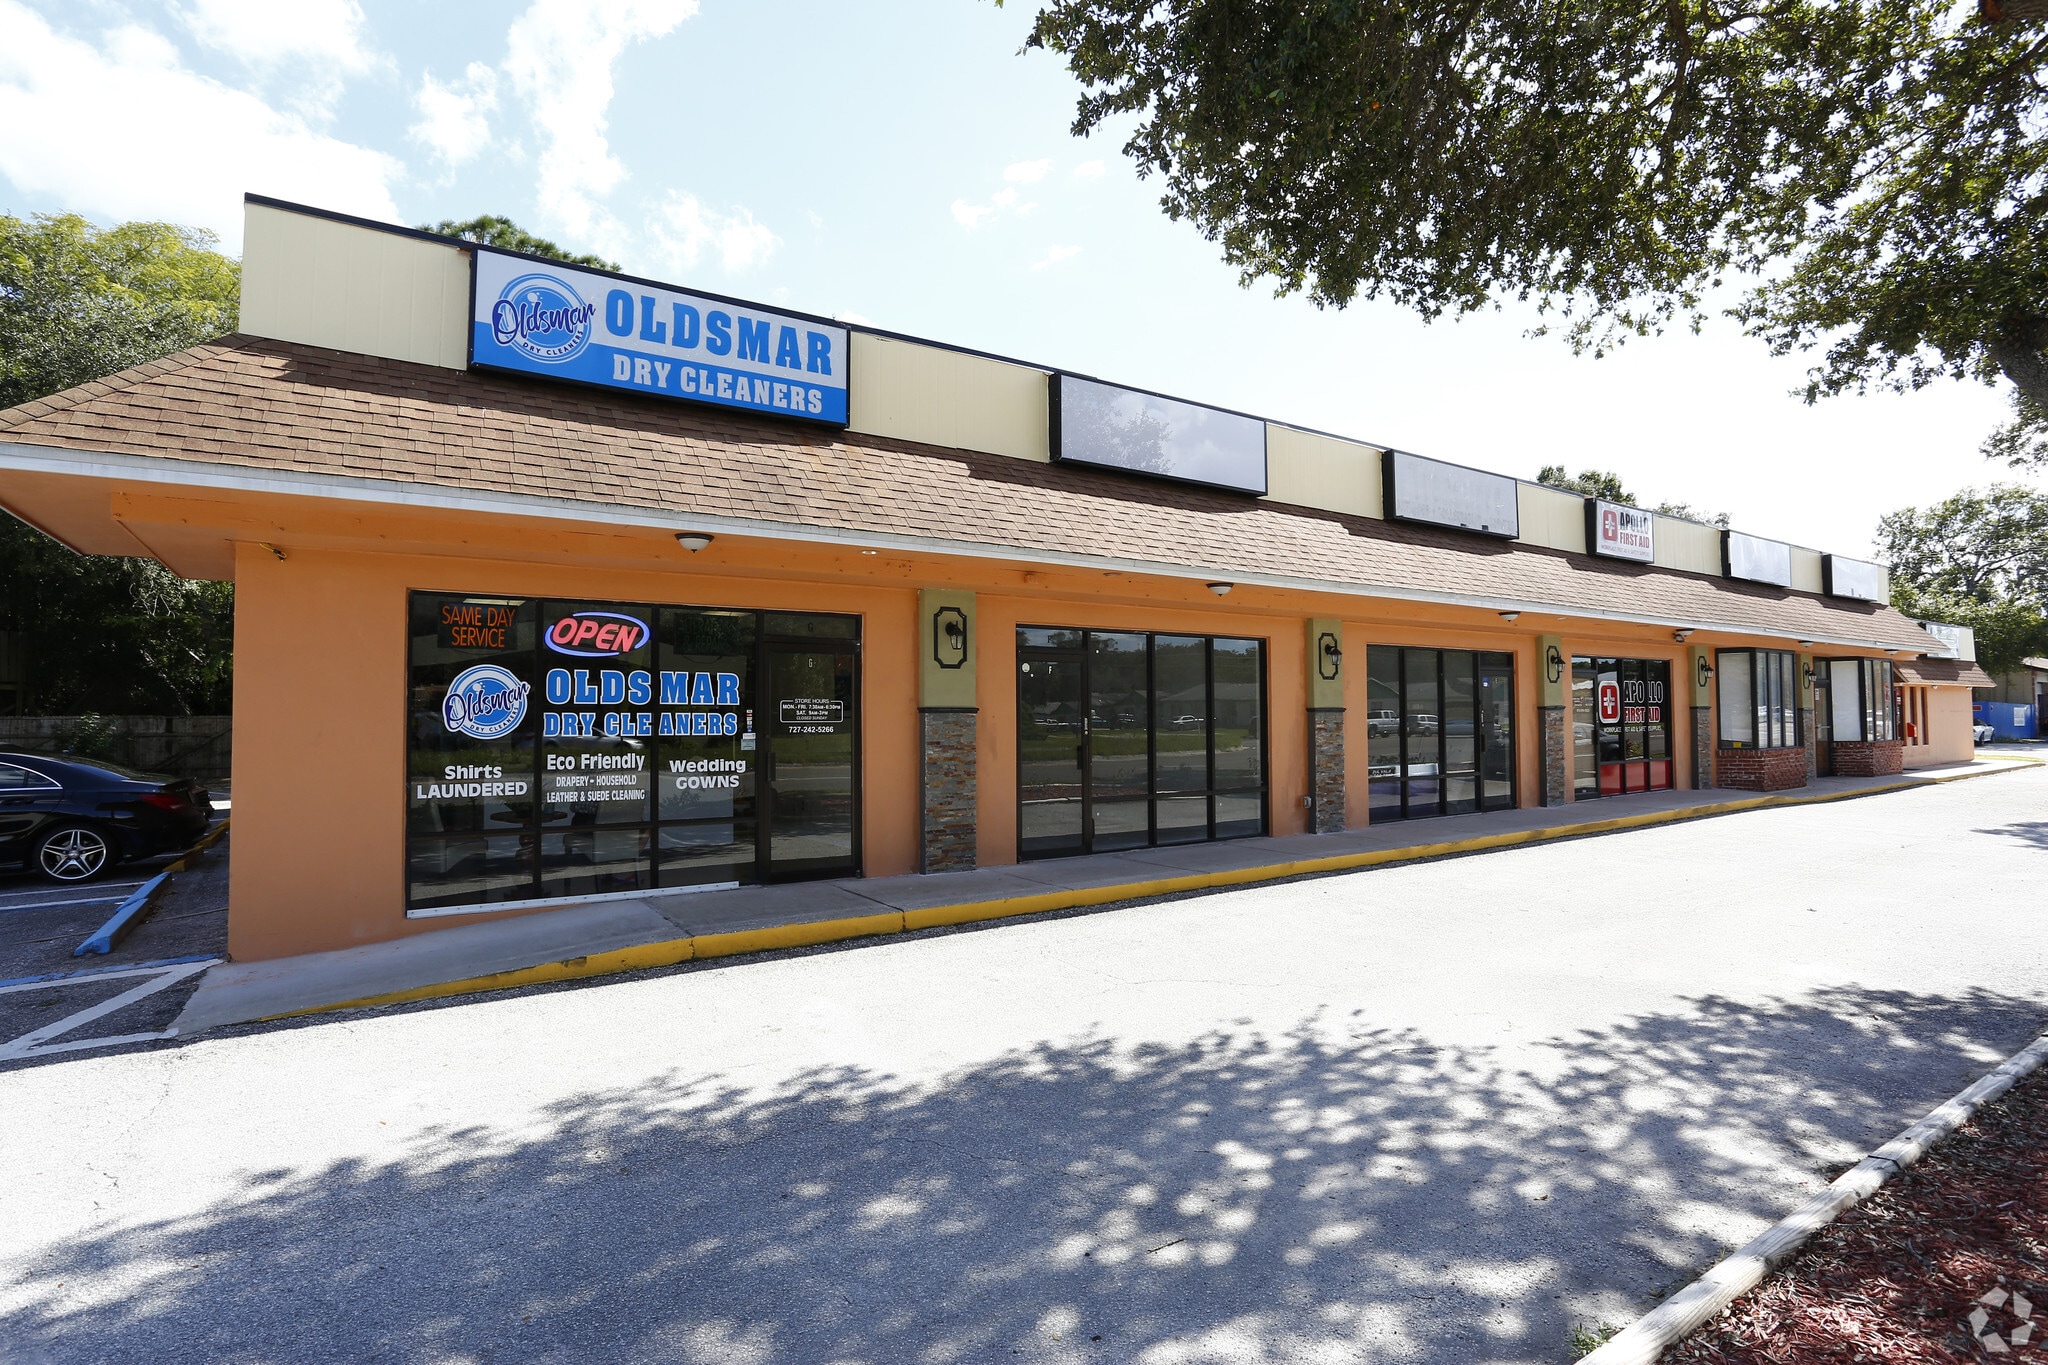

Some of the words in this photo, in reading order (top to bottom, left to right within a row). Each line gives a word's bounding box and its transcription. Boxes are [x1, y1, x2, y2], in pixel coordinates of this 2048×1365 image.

[492, 299, 596, 345] Oldsmar
[605, 288, 832, 376] OLDSMAR
[523, 341, 541, 354] DRY
[546, 330, 584, 356] CLEANERS
[612, 353, 671, 389] DRY
[680, 366, 823, 414] CLEANERS
[1620, 511, 1649, 534] APOLLO
[1620, 531, 1638, 546] FIRST
[1638, 535, 1650, 548] AID
[441, 605, 482, 626] SAME
[487, 607, 516, 628] DAY
[451, 627, 505, 648] SERVICE
[552, 617, 640, 653] OPEN
[444, 681, 530, 730] Oldsmar
[1624, 706, 1645, 723] FIRST
[470, 724, 484, 732] DRY
[489, 707, 518, 732] CLEANERS
[543, 712, 596, 737] DRY
[444, 764, 502, 780] Shirts
[547, 754, 575, 770] Eco
[581, 752, 645, 771] Friendly
[669, 758, 747, 774] Wedding
[417, 781, 528, 799] LAUNDERED
[556, 776, 589, 787] DRAPERY
[596, 774, 637, 786] HOUSEHOLD
[675, 775, 740, 789] GOWNS
[547, 792, 578, 803] LEATHER
[580, 791, 585, 802] &
[587, 790, 610, 801] SUEDE
[611, 789, 645, 801] CLEANING
